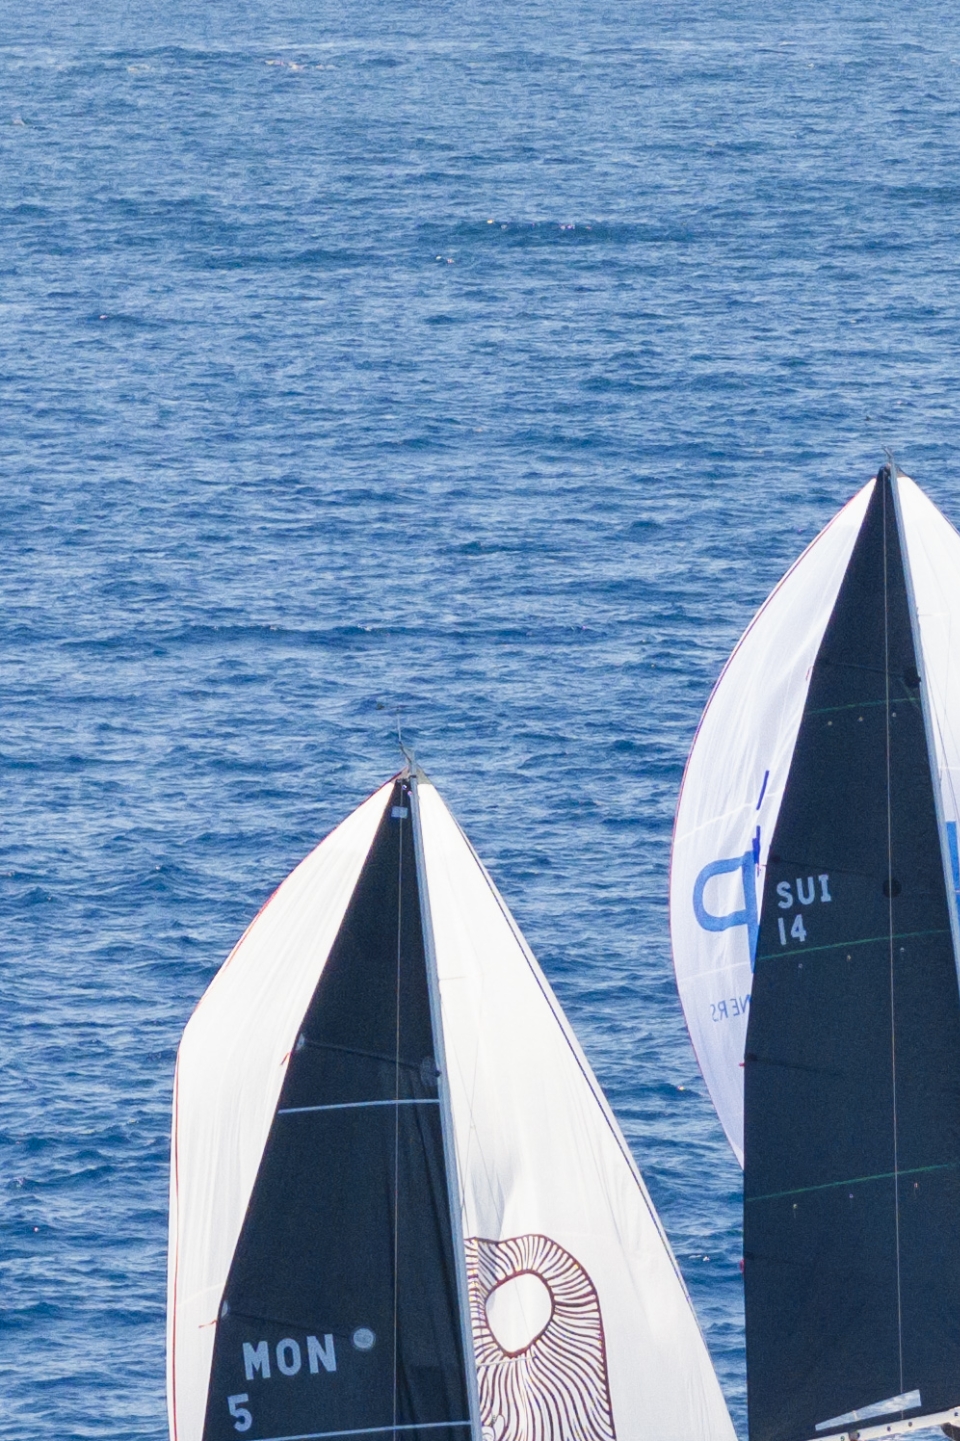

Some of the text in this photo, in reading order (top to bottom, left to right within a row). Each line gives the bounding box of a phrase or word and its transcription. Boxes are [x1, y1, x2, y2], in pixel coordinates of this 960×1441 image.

[776, 874, 832, 909] SUI
[778, 914, 807, 945] 14
[242, 1333, 337, 1380] MON
[227, 1393, 253, 1432] 5
